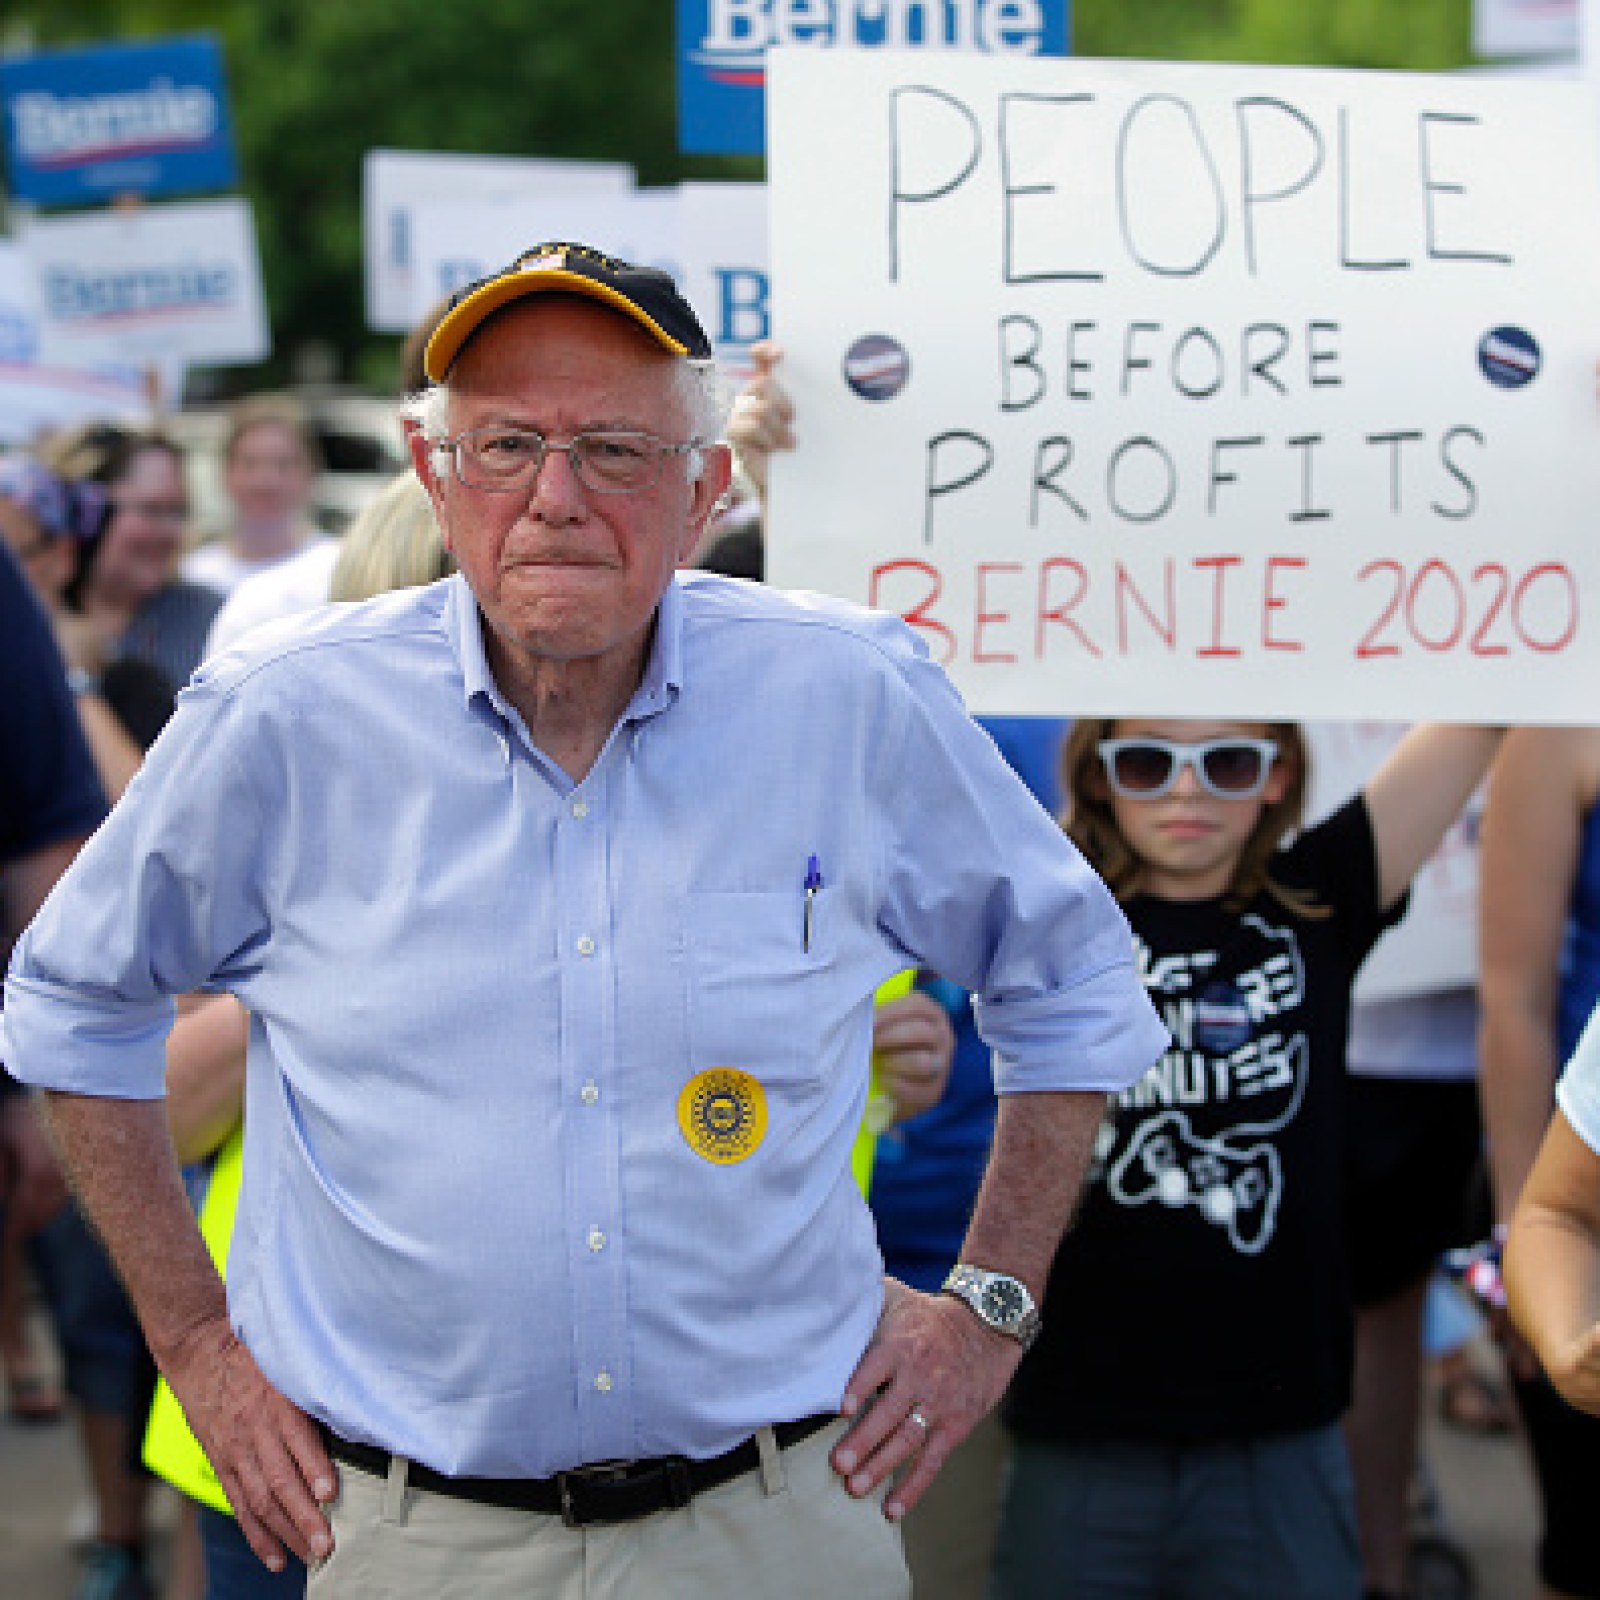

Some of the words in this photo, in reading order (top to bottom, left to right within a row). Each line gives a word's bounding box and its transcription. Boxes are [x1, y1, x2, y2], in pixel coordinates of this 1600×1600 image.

[888, 84, 1514, 285] PEOPLE
[998, 315, 1343, 412] BEFORE
[924, 424, 1485, 545] PROFITS
[870, 556, 1307, 664] BERNIE
[1355, 558, 1580, 658] 2020
